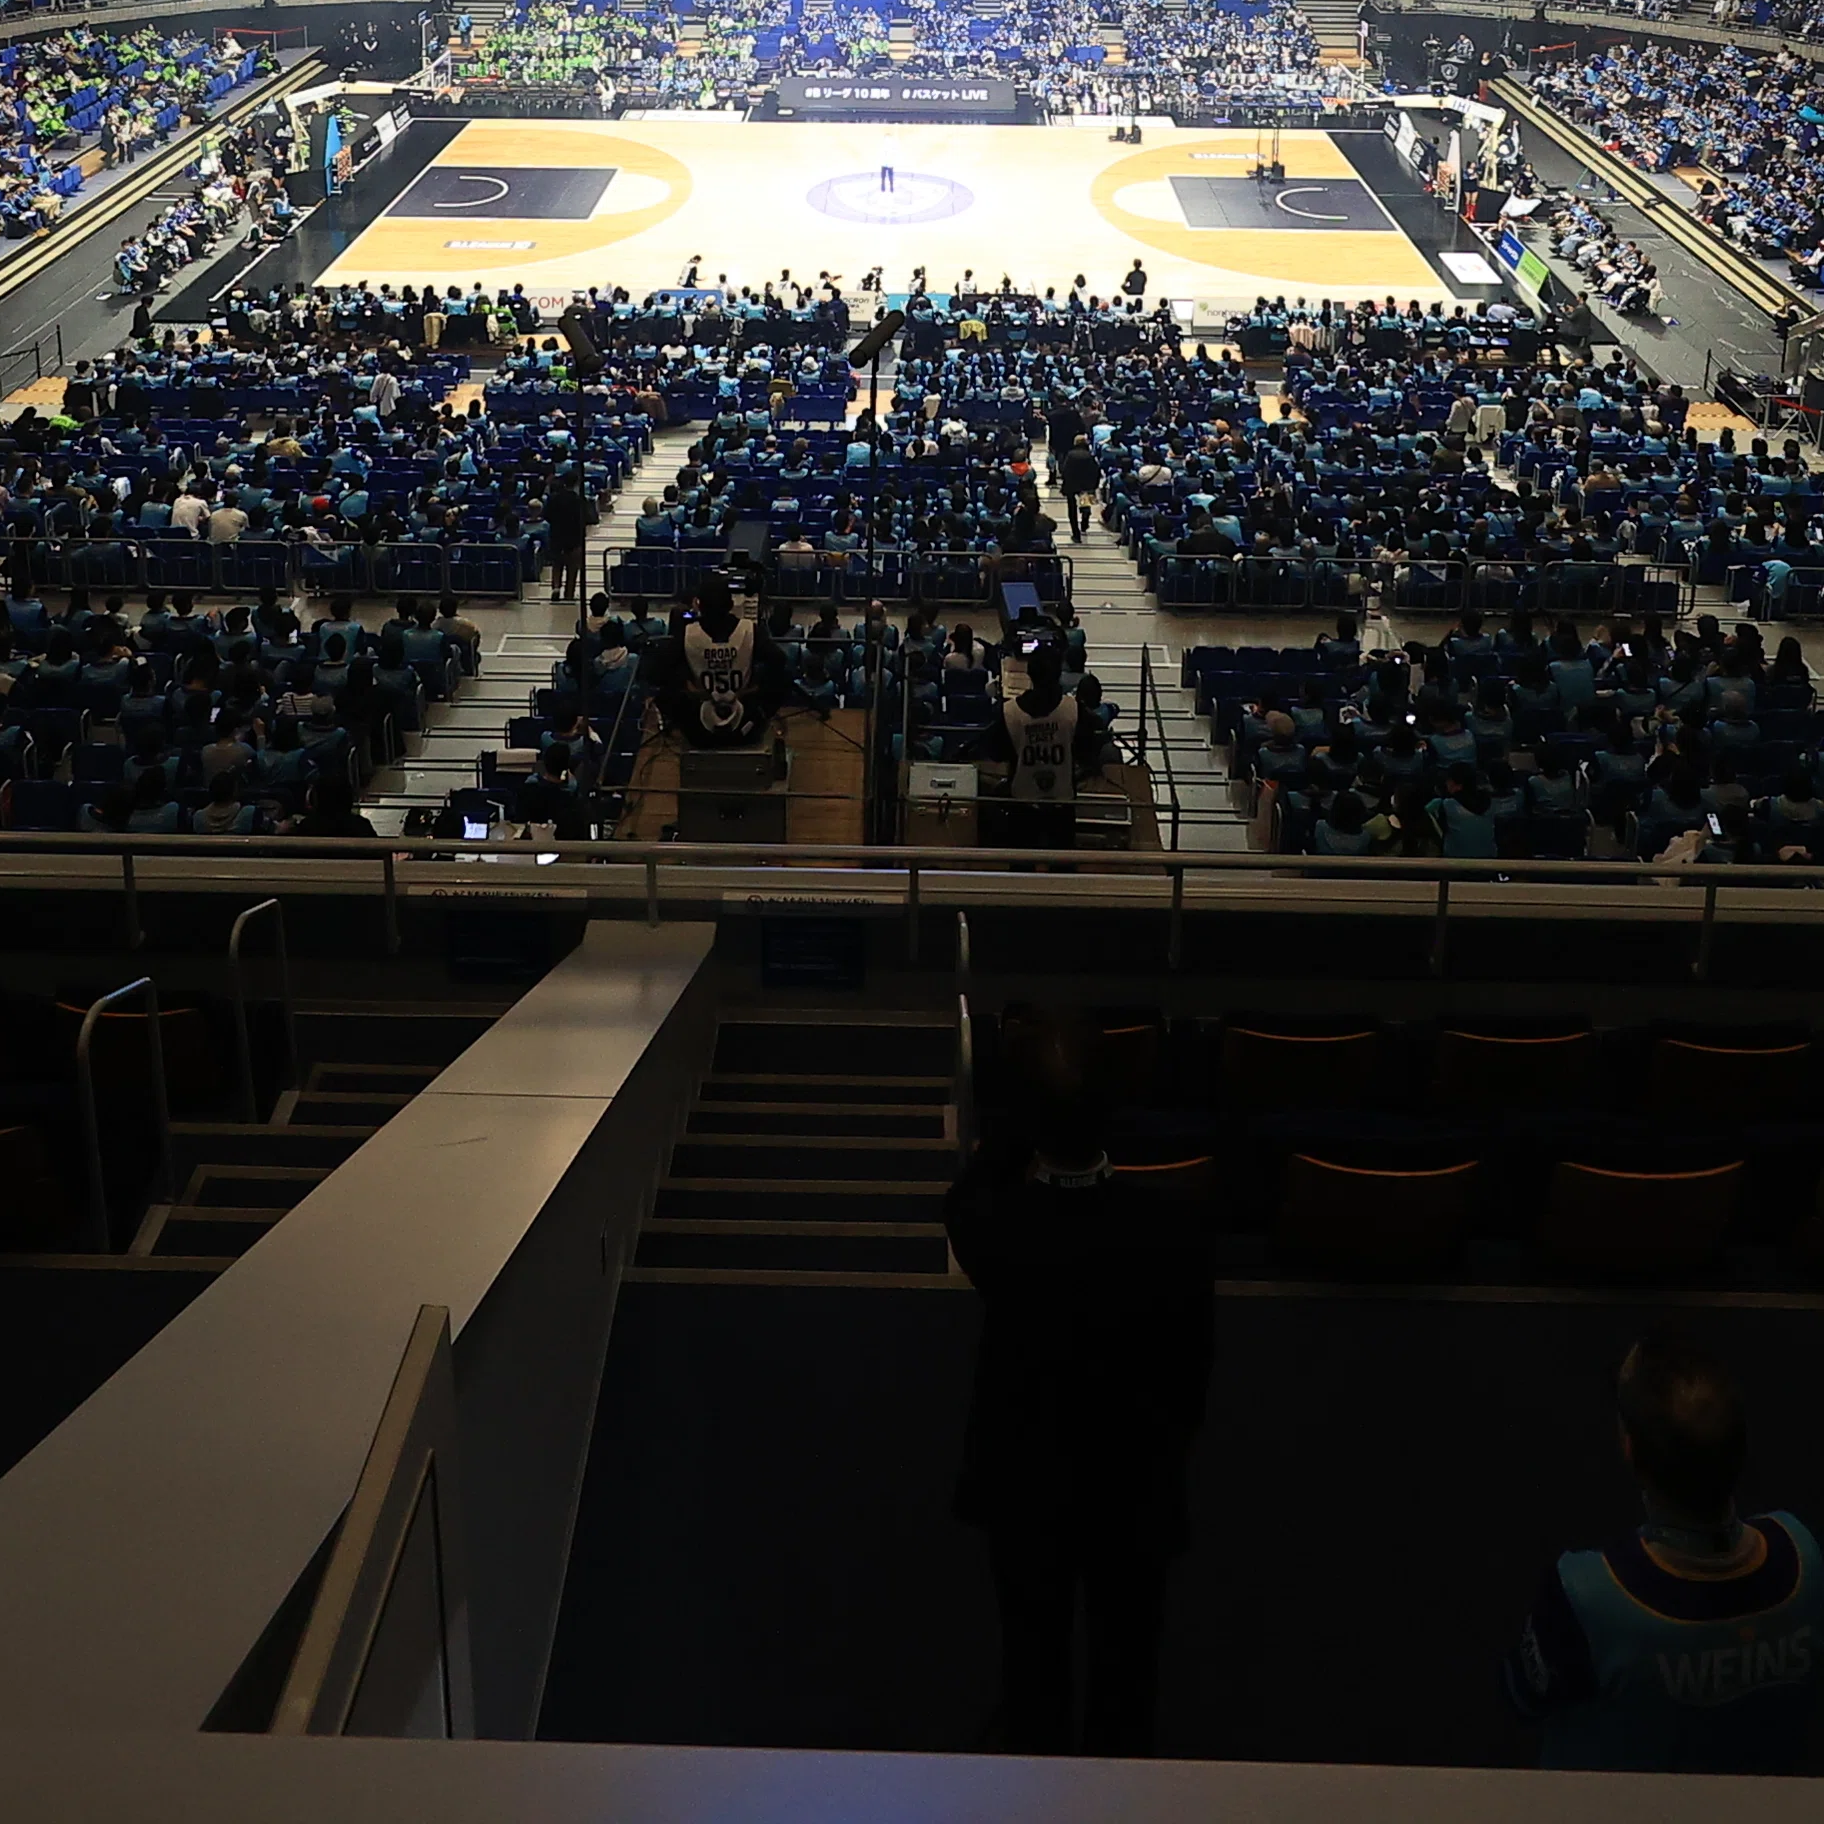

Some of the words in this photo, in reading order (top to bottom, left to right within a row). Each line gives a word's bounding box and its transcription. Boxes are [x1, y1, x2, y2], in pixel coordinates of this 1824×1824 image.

[704, 647, 737, 660] BROAD
[701, 670, 743, 693] 050
[1023, 744, 1064, 766] 040
